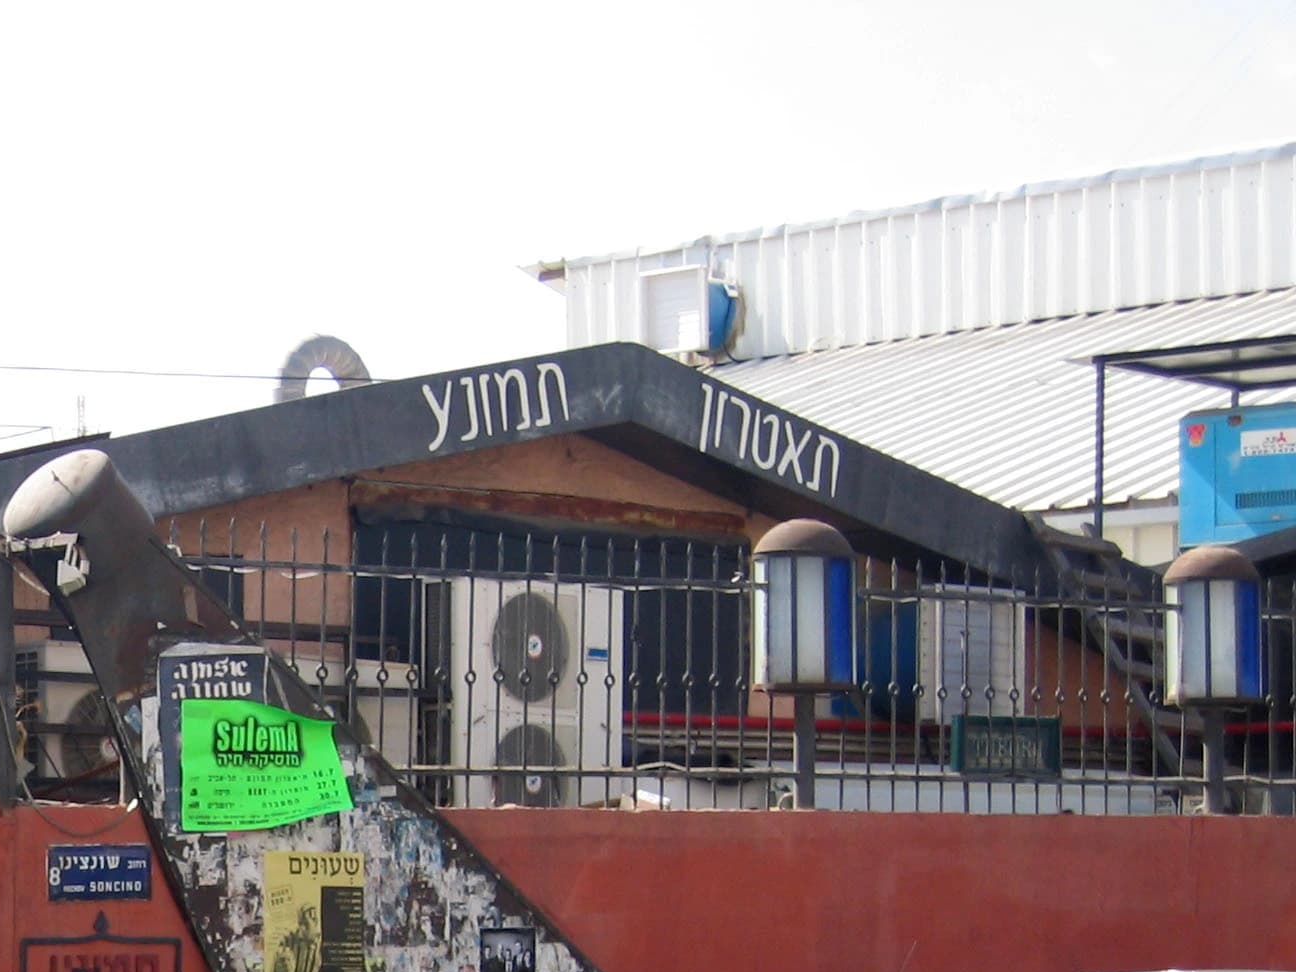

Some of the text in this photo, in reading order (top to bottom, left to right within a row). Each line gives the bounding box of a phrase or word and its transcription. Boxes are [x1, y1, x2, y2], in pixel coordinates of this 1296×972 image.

[699, 383, 841, 498] תאטרון
[171, 680, 251, 700] שחורה
[216, 752, 301, 769] מוסיקה חיה
[58, 855, 147, 871] רחוב שונצינו
[49, 866, 61, 886] 8
[89, 880, 142, 893] SONCINO
